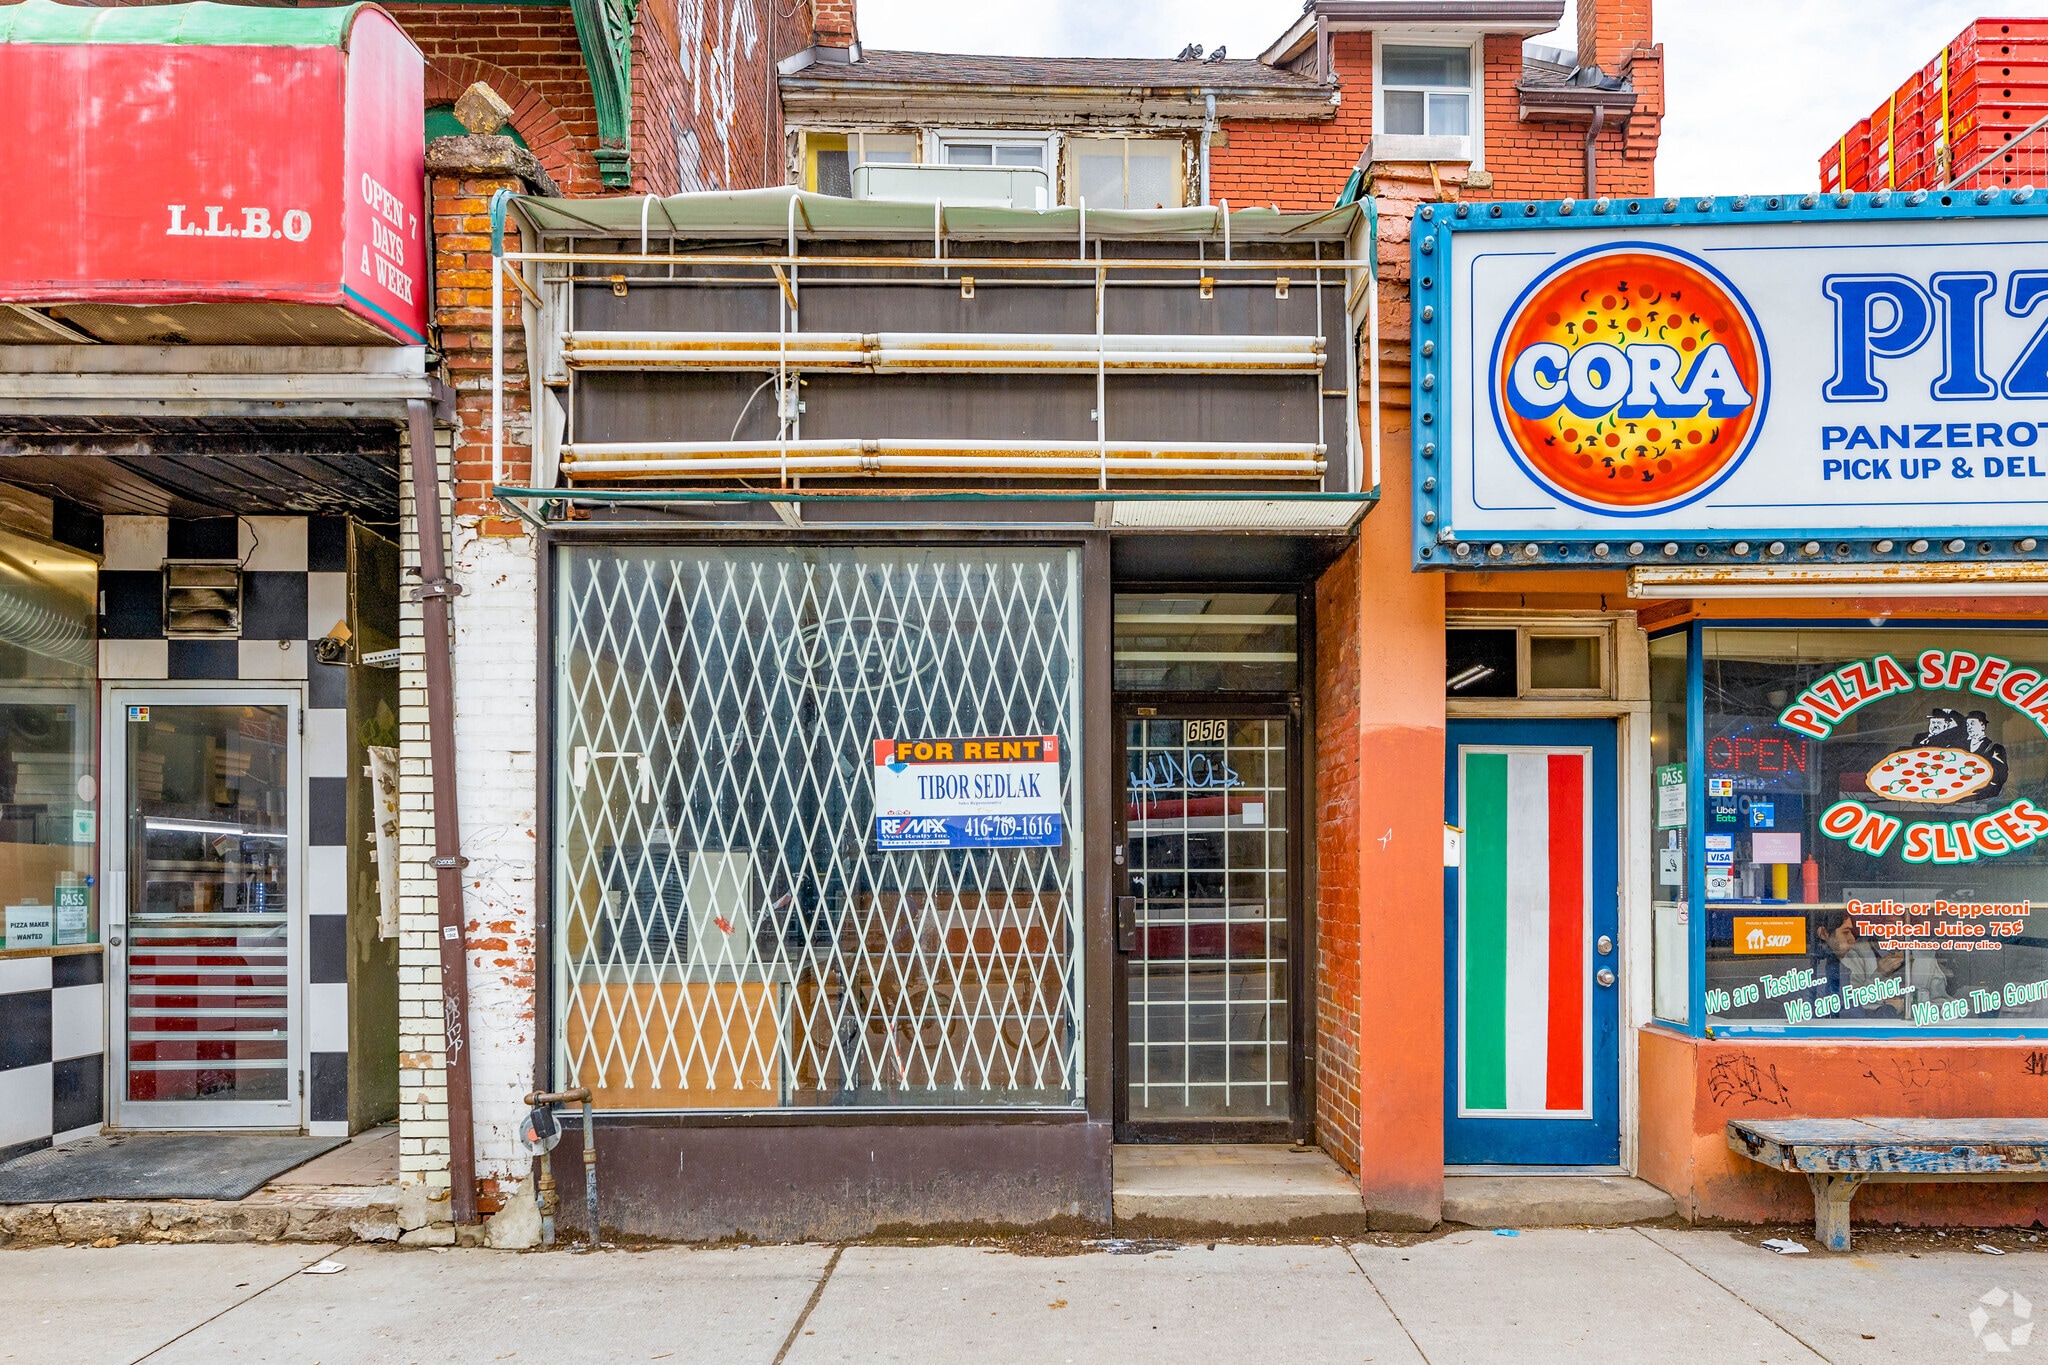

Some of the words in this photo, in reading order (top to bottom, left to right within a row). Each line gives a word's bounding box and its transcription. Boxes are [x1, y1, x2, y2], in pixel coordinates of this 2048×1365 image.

[361, 172, 403, 230] OPEN
[409, 213, 417, 240] 7
[166, 205, 312, 241] L.L.B.O
[371, 216, 404, 266] DAYS
[361, 244, 371, 277] A
[374, 252, 414, 306] WEEK
[1507, 343, 1752, 419] CORA
[1823, 458, 1892, 480] PICK
[1900, 458, 1941, 479] UP
[1951, 456, 1974, 479] &
[1983, 456, 2046, 478] DEL
[797, 634, 915, 674] OPEN
[1781, 656, 1913, 738] PIZZA
[1188, 721, 1226, 740] 656
[897, 741, 954, 761] FOR
[964, 741, 1041, 760] RENT
[1708, 737, 1806, 772] OPEN
[918, 775, 970, 800] TIBOR
[974, 773, 1041, 799] SEDLAK
[1662, 770, 1683, 785] PASS
[1716, 806, 1737, 814] Uber
[1716, 814, 1737, 822] Eats
[881, 817, 947, 834] RE/MAX
[964, 815, 1053, 836] 416-769-1616
[1821, 803, 1900, 854] ON
[1905, 801, 2048, 861] SLICES
[1711, 853, 1731, 861] VISA
[60, 893, 84, 906] PASS
[1847, 900, 1905, 915] Garlic
[1910, 903, 1931, 915] or
[1935, 901, 2030, 918] Pepperoni
[1766, 935, 1792, 947] SKIP
[1857, 922, 1929, 938] Tropical
[1935, 922, 1985, 936] Juice
[1990, 920, 2024, 937] 75¢
[1879, 941, 1939, 950] w/Purchase
[1942, 941, 1953, 949] of
[1976, 941, 2001, 949] slice
[1705, 990, 1730, 1014] We
[1733, 984, 1759, 1007] are
[1760, 968, 1828, 998] Tastier...
[1784, 999, 1812, 1024] We
[1815, 995, 1840, 1018] are
[1843, 977, 1915, 1009] Fresher...
[1912, 1002, 1939, 1026] We
[1942, 999, 1968, 1020] are
[1970, 989, 2001, 1014] The
